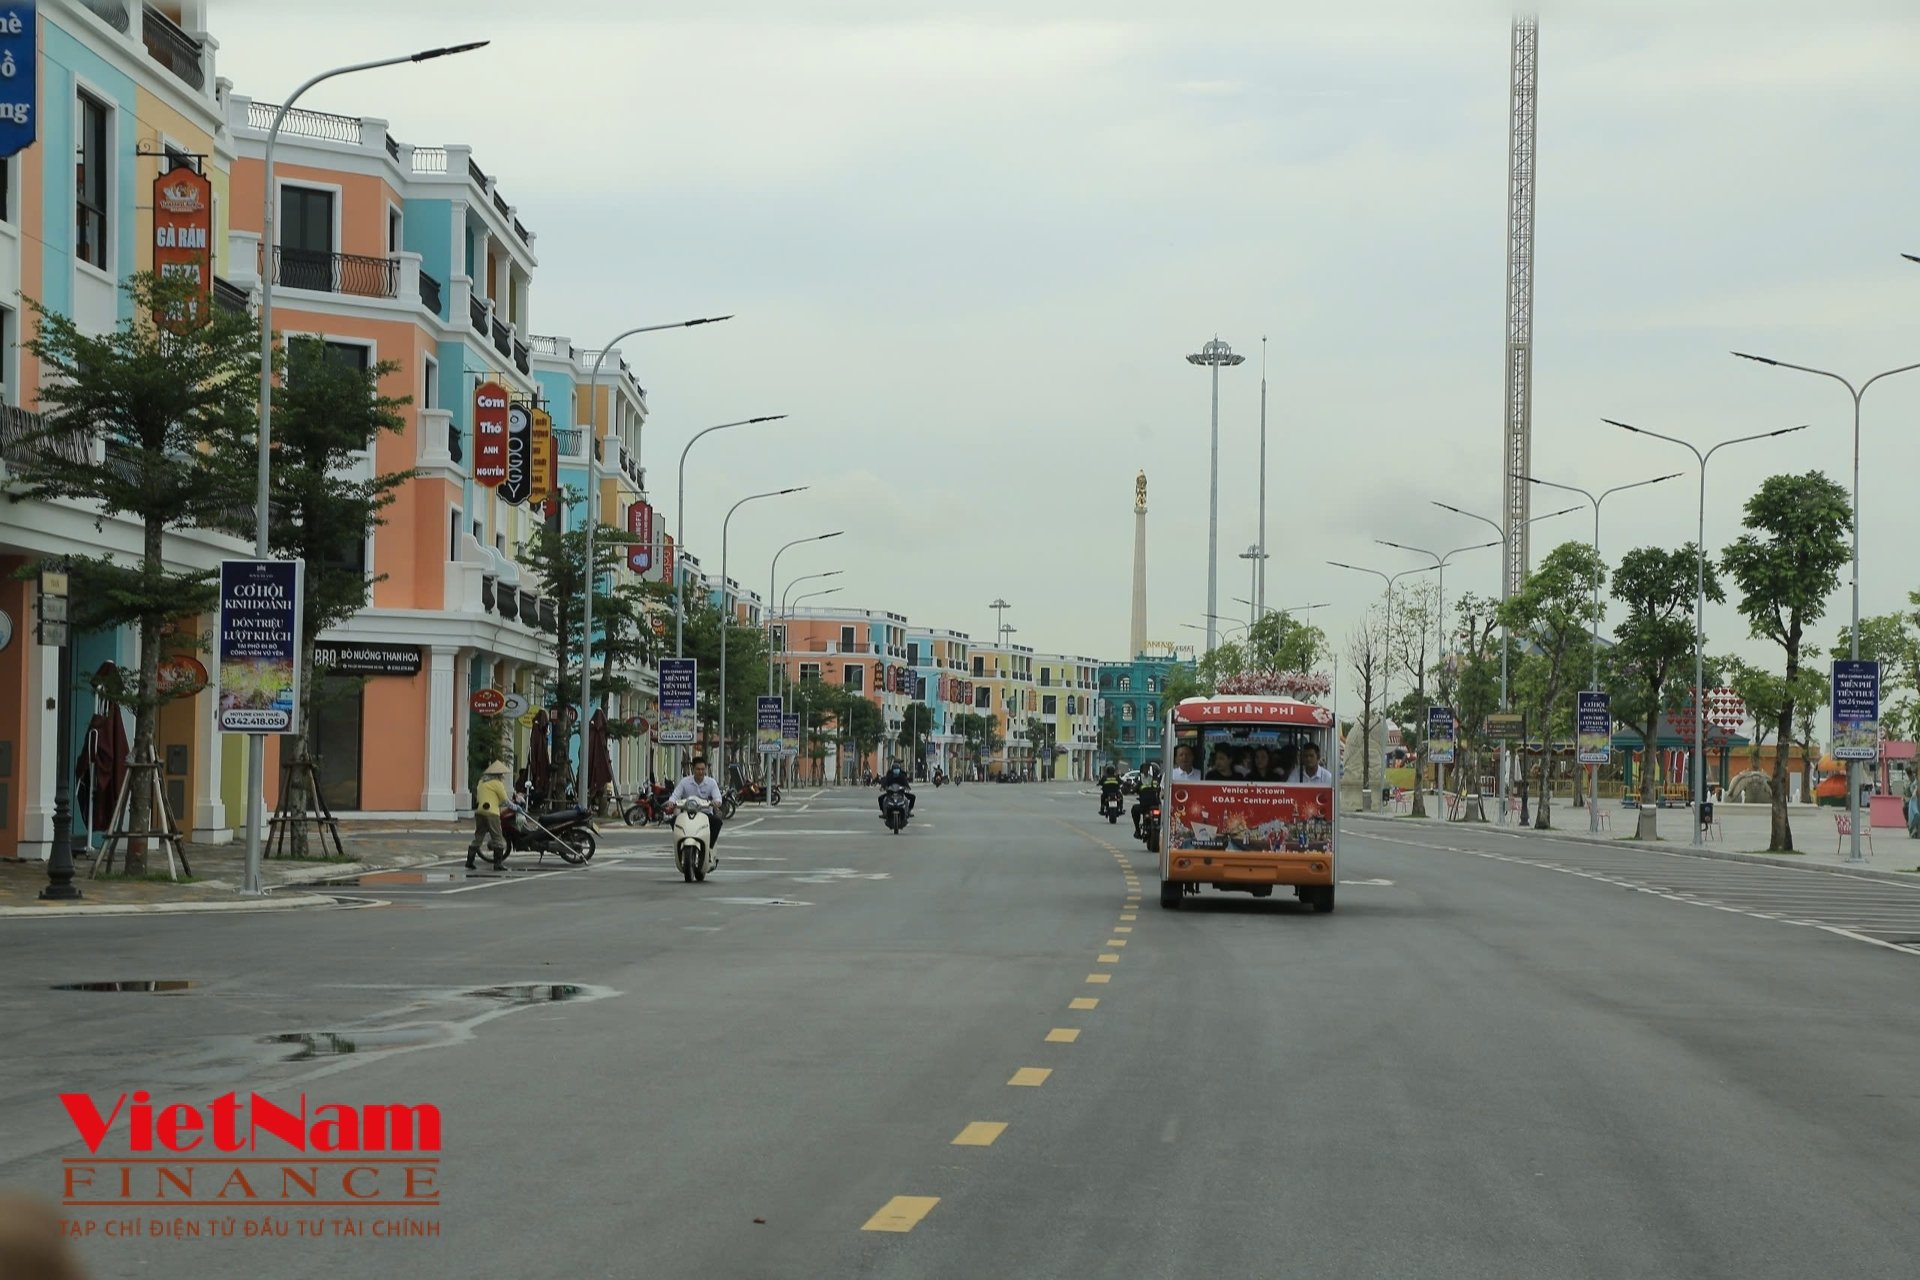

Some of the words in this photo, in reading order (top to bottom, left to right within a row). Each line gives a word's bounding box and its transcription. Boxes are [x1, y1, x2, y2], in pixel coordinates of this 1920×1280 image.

[156, 223, 176, 247] GÀ
[178, 224, 206, 248] RÁN
[234, 583, 256, 597] CƠ
[257, 582, 283, 600] HỘI
[225, 600, 252, 609] KINH
[252, 600, 292, 610] DOANH
[254, 631, 291, 641] KHÁCH
[342, 648, 352, 659] BÒ
[382, 652, 402, 662] THAN
[1203, 706, 1221, 714] XE
[1270, 706, 1294, 715] PHÍ
[224, 718, 286, 726] 0342.418.058
